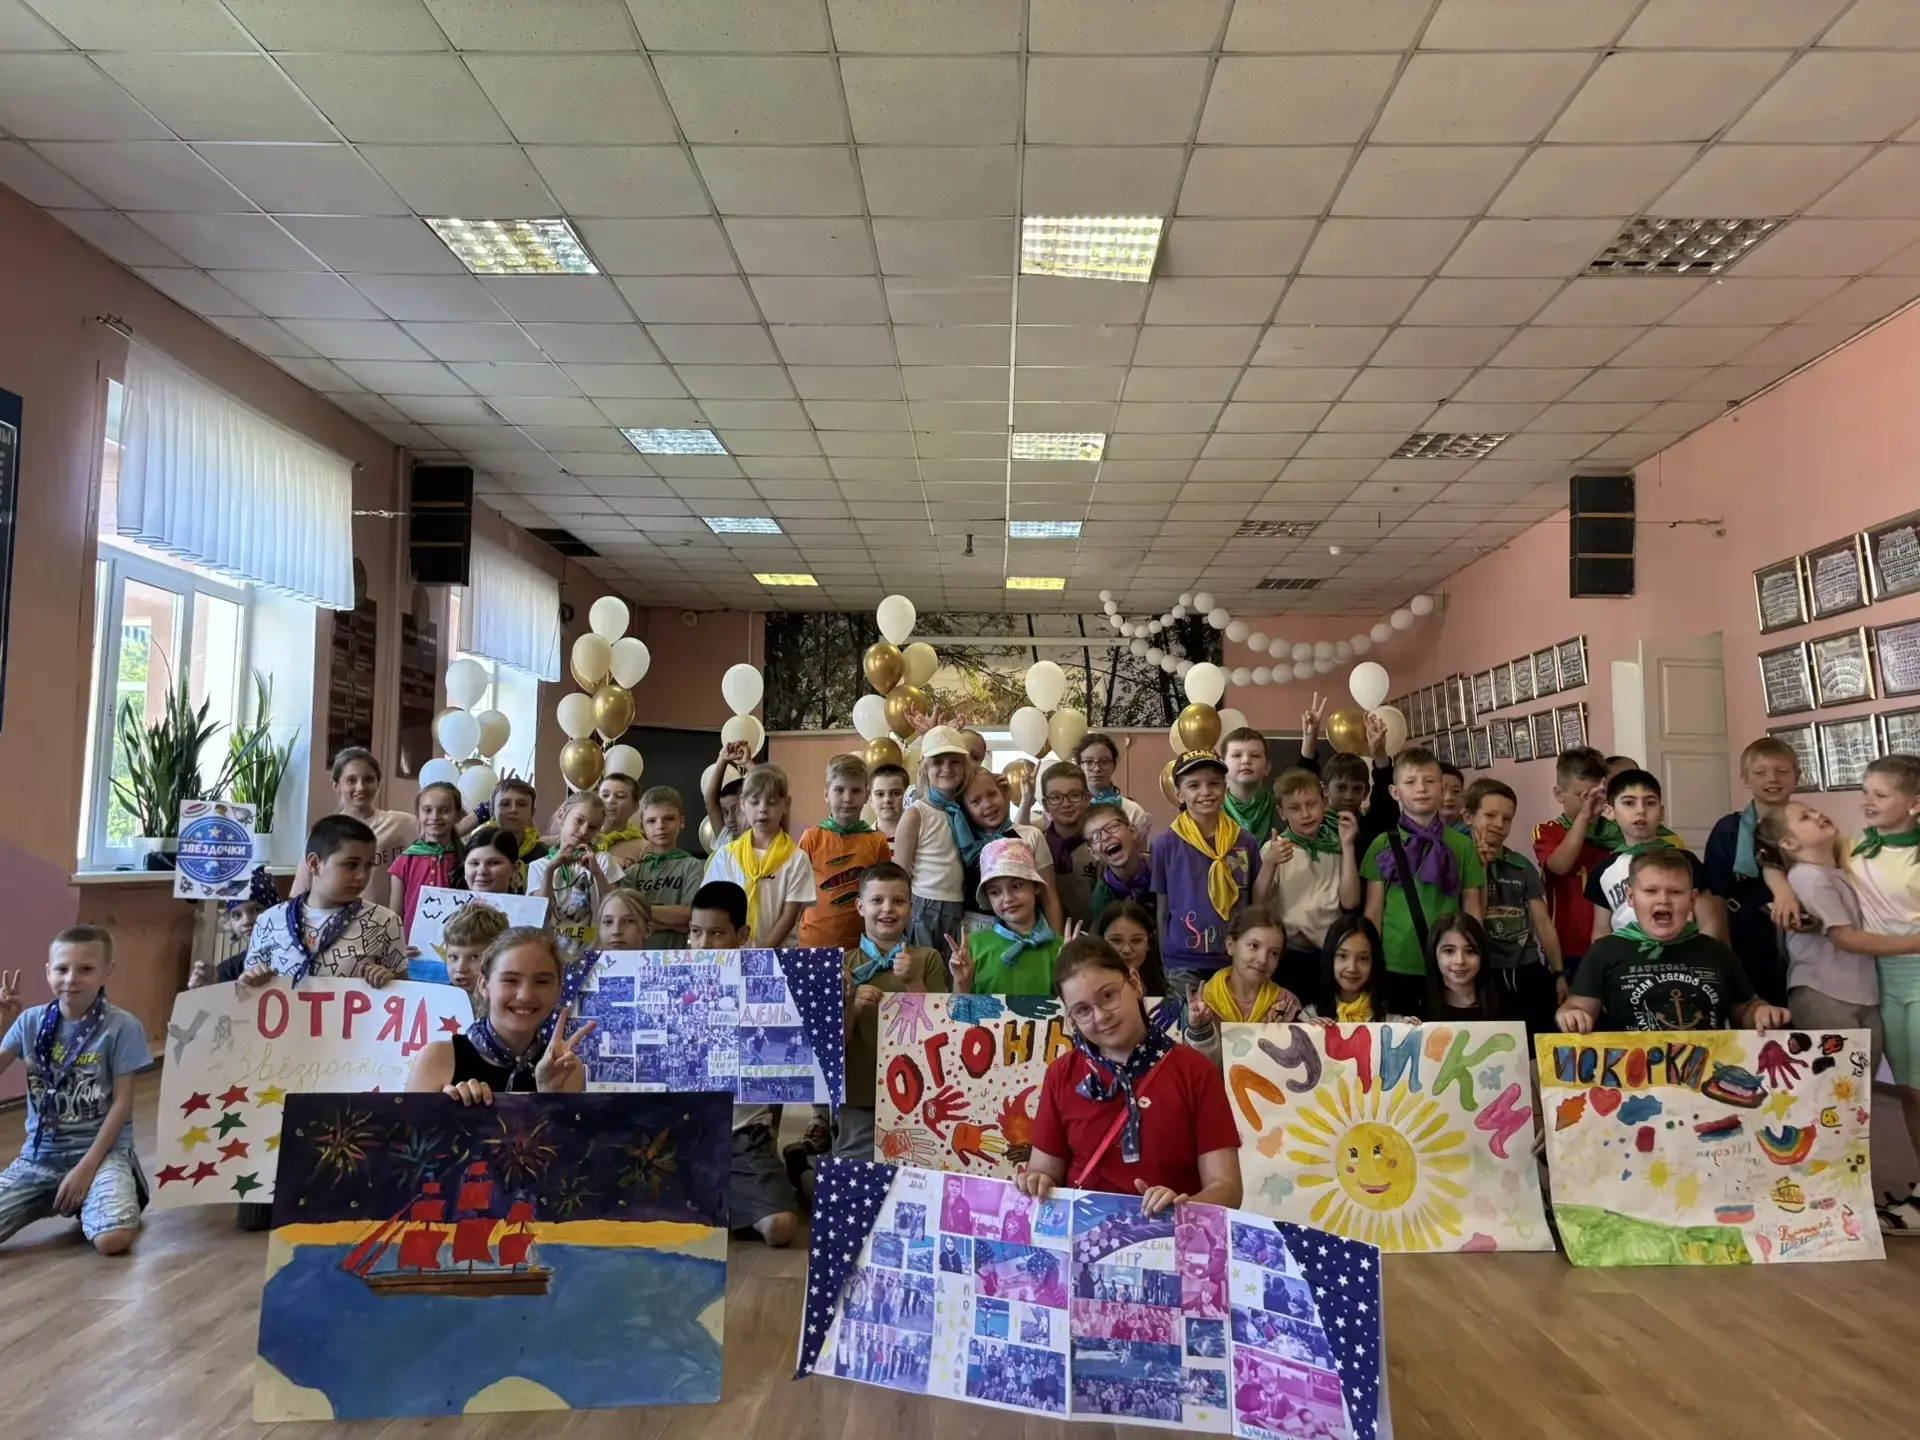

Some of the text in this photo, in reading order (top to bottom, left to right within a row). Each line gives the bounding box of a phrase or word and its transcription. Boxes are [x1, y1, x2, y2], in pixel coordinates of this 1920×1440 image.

[636, 876, 683, 892] EGEND
[1180, 911, 1216, 953] Sp
[1630, 978, 1654, 1005] OCEAN
[1655, 972, 1700, 986] LEGENDS
[1701, 983, 1719, 1005] CLUB
[257, 988, 428, 1057] ОТРЯД
[740, 1004, 792, 1026] ДЕНЬ
[886, 1017, 1075, 1115] ОГОНЬ
[1553, 1042, 1710, 1092] ИСКОРКИ
[1229, 1024, 1532, 1159] ЛУЧИКИ
